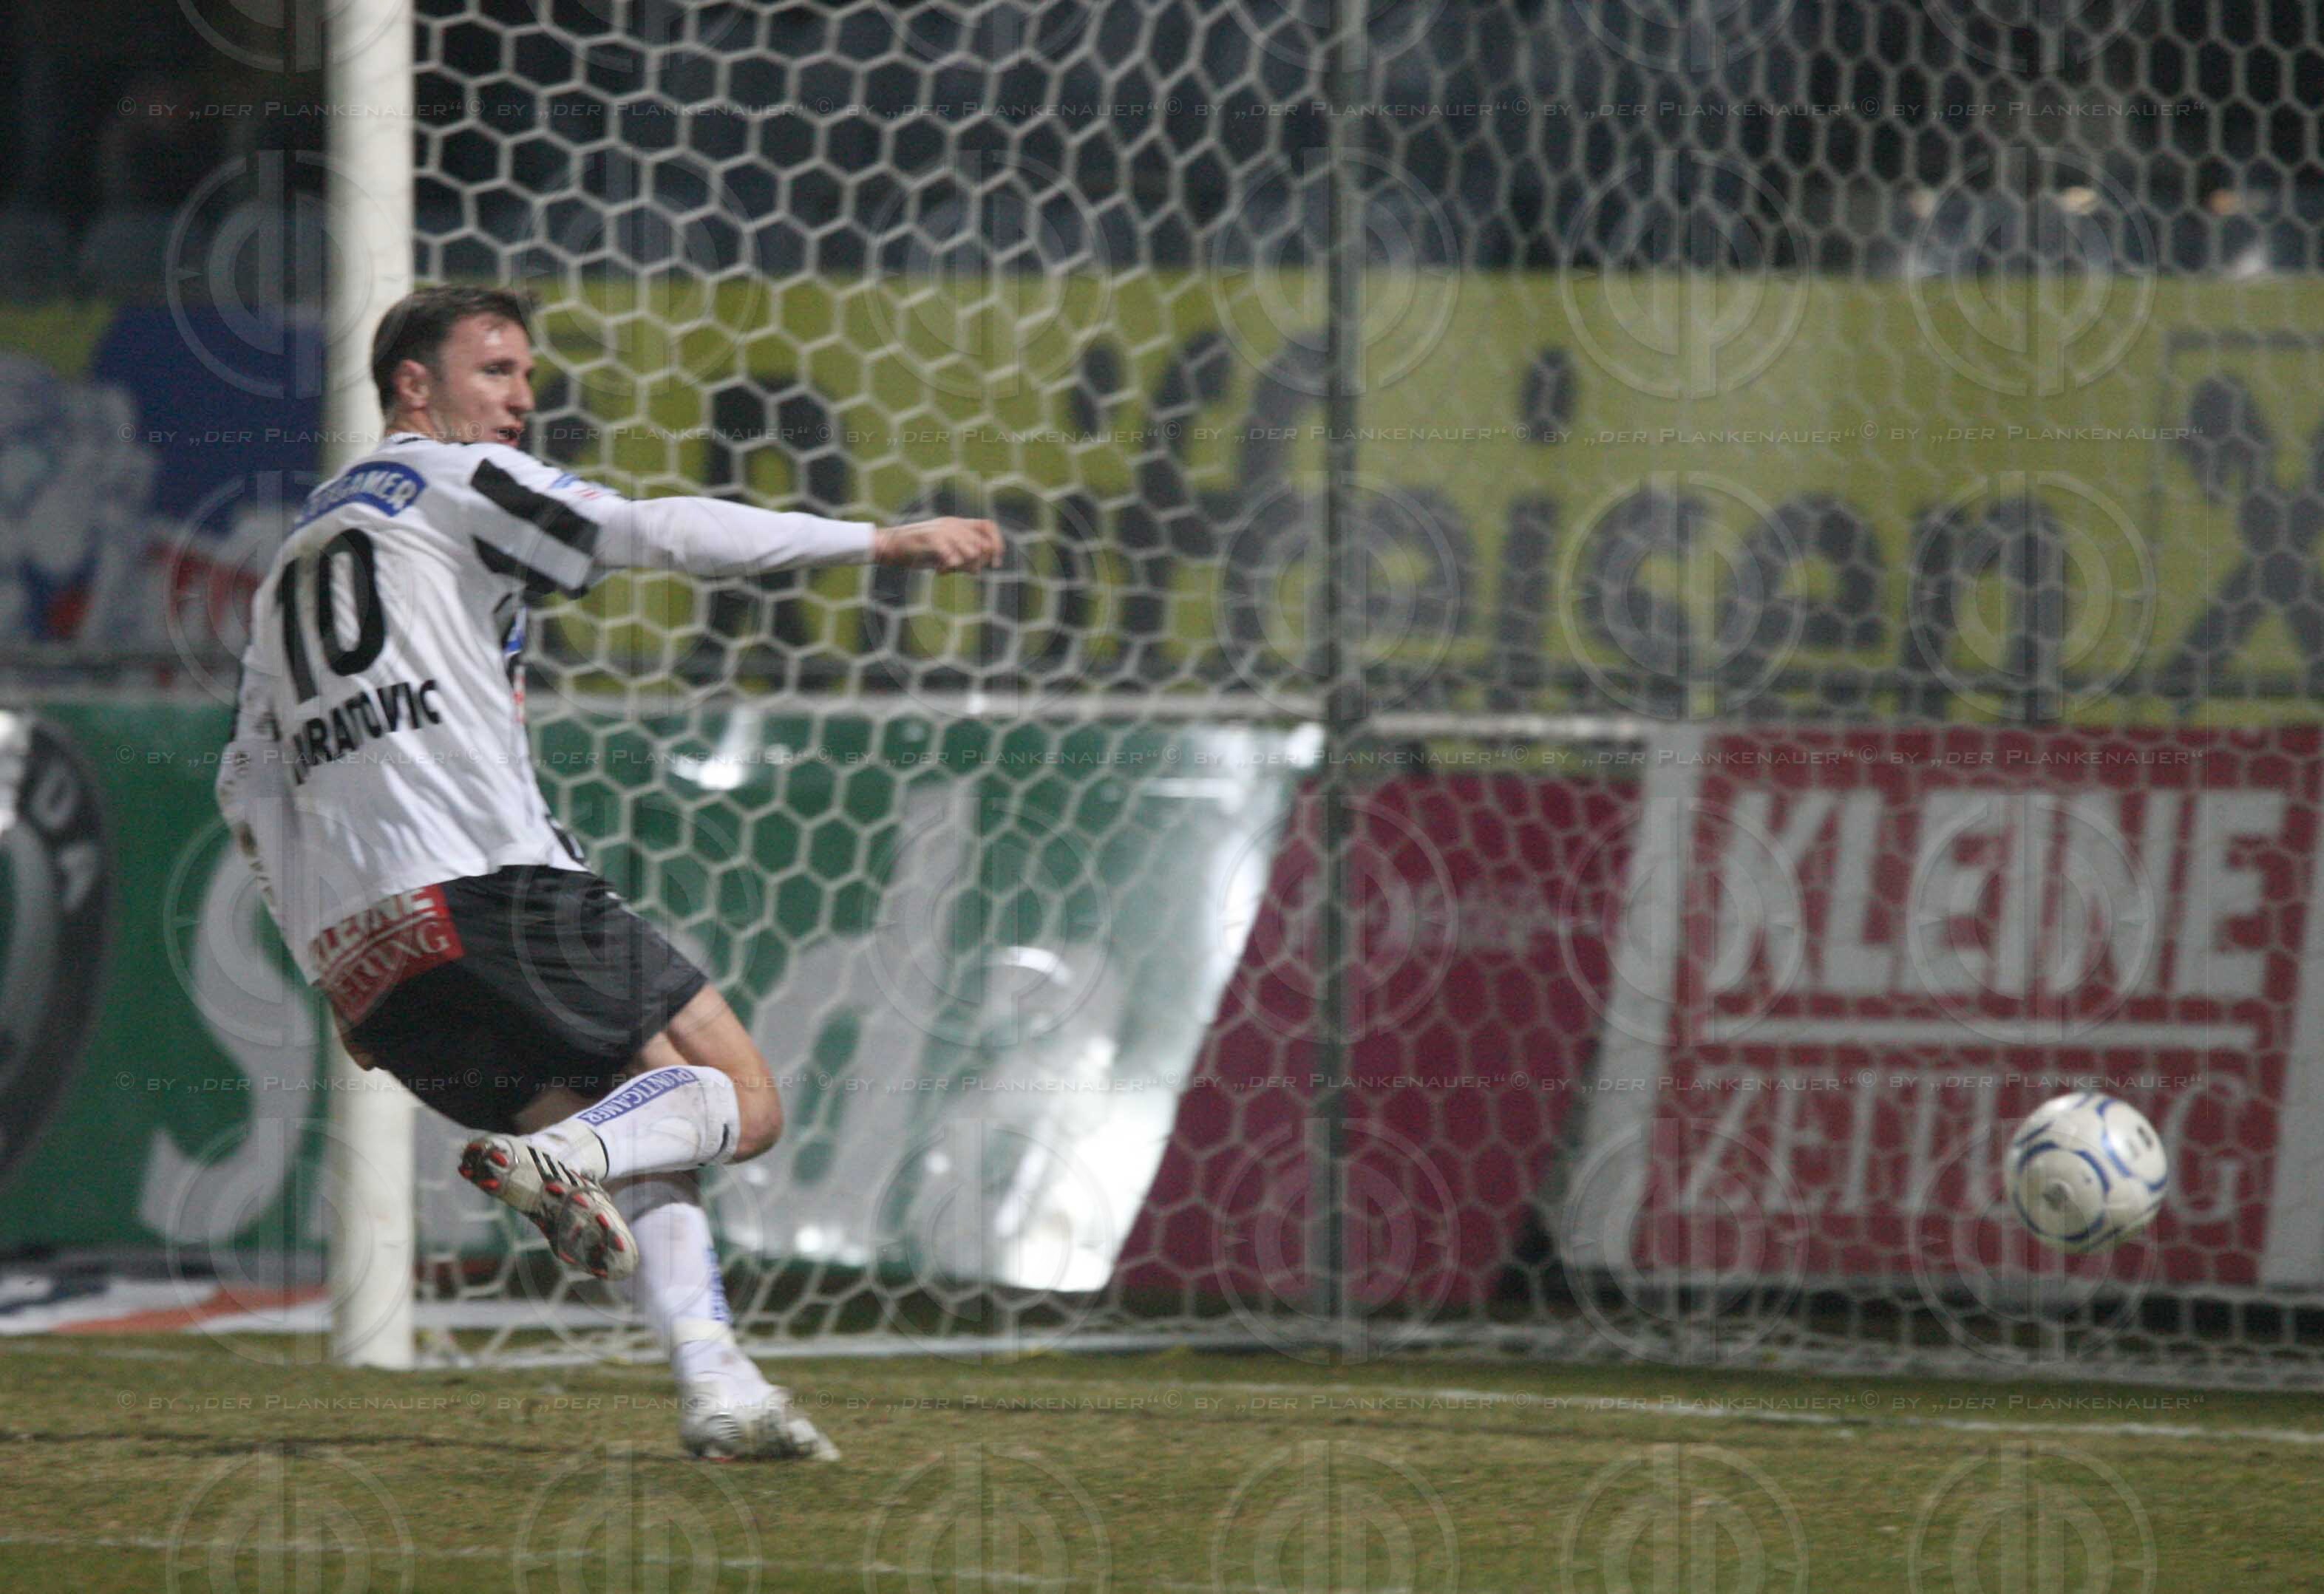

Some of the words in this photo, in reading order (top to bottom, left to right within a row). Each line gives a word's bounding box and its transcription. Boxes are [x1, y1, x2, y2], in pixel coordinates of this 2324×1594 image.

[275, 528, 385, 704] 10
[1705, 788, 2289, 998] KLEINE
[1674, 1066, 2247, 1224] ZEITUG
